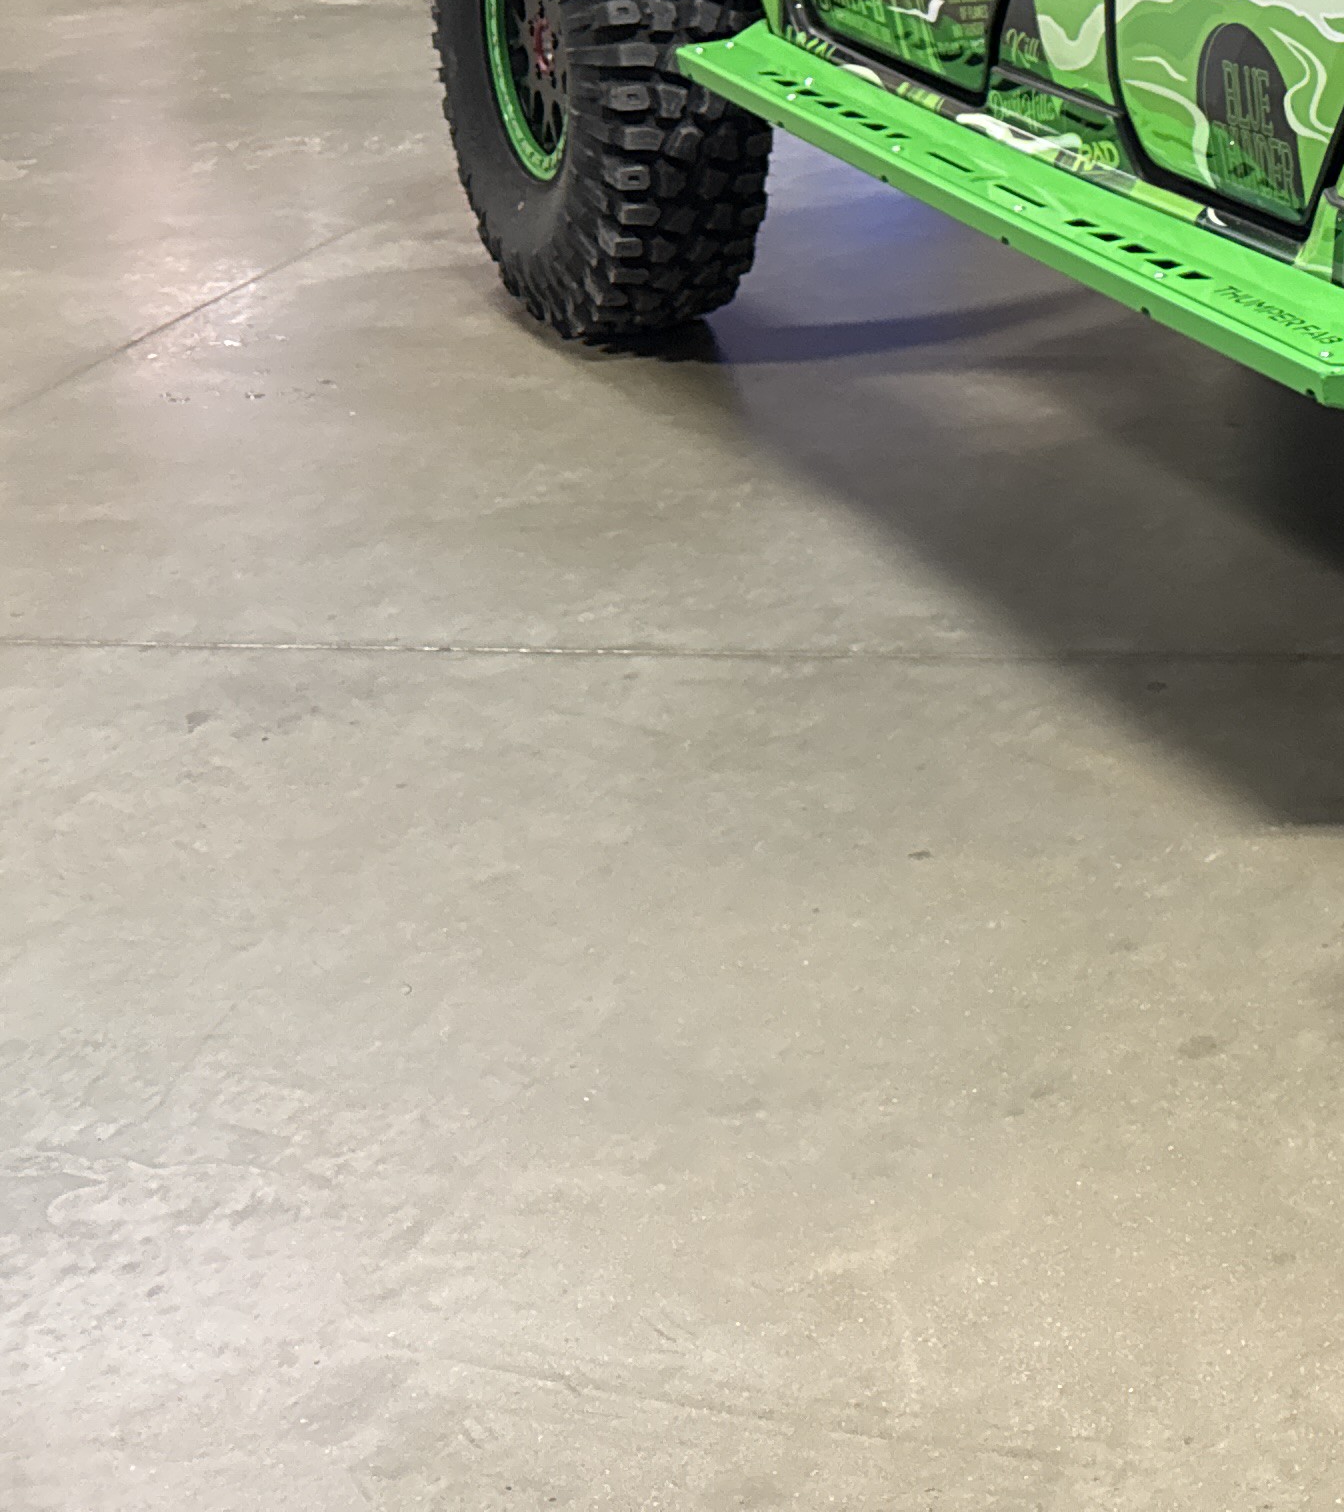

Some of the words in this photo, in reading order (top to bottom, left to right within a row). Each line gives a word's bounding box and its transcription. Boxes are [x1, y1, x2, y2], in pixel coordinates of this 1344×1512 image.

[1222, 59, 1275, 138] BLUE
[1214, 285, 1302, 329] THUMPER
[1300, 323, 1343, 345] FAB
